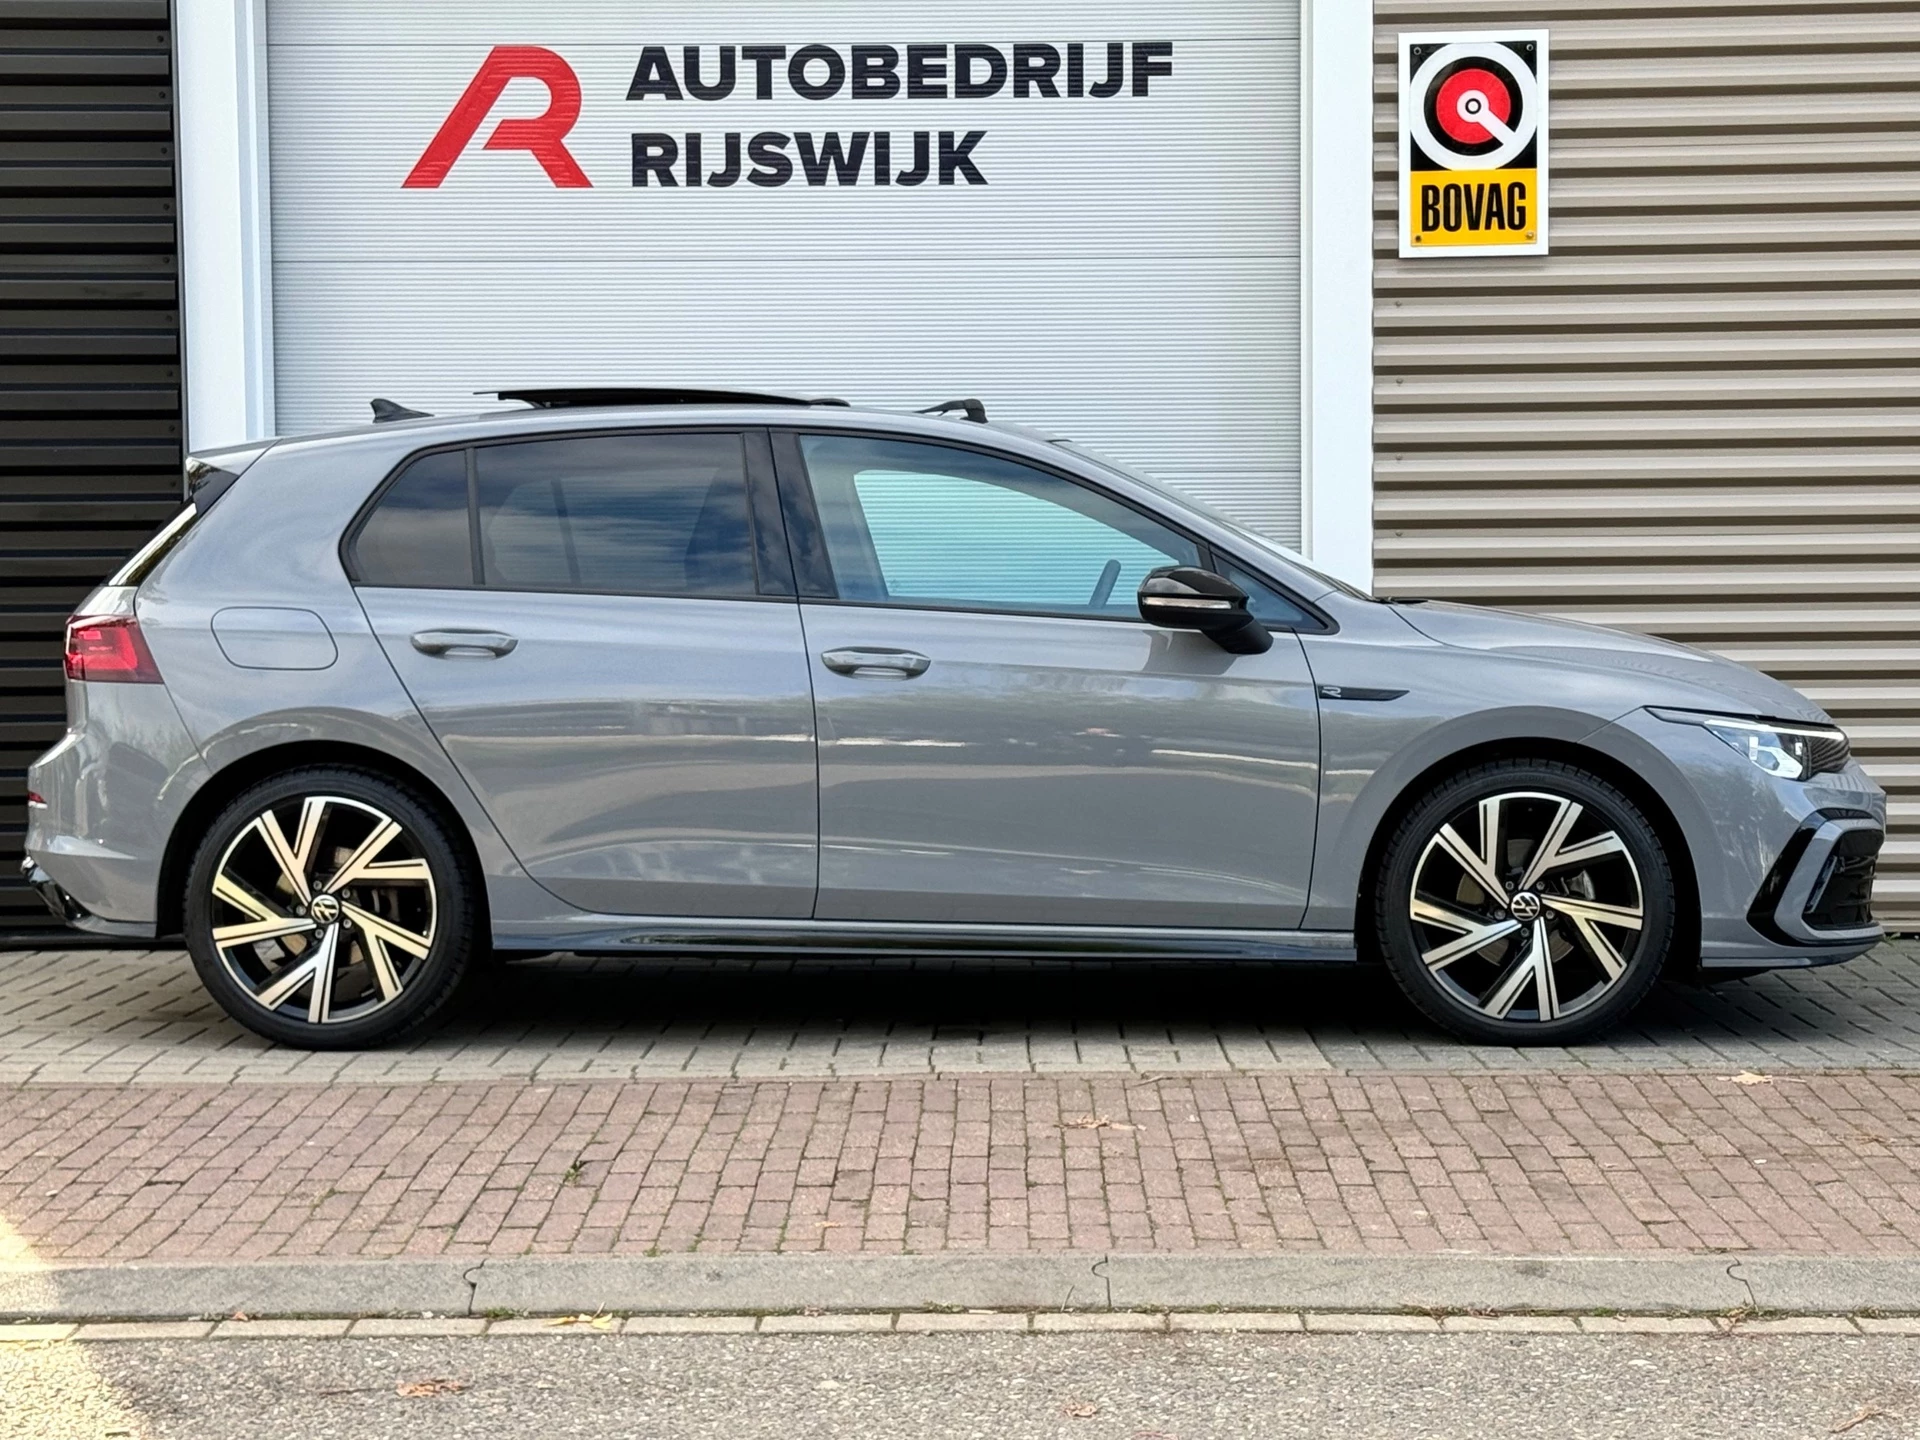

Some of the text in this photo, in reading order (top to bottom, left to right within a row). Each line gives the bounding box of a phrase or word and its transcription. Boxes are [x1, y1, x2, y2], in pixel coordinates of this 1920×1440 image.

[625, 42, 1174, 101] AUTOBEDRIJF
[631, 130, 988, 188] RIJSWIJK
[1421, 181, 1527, 232] BOVAG
